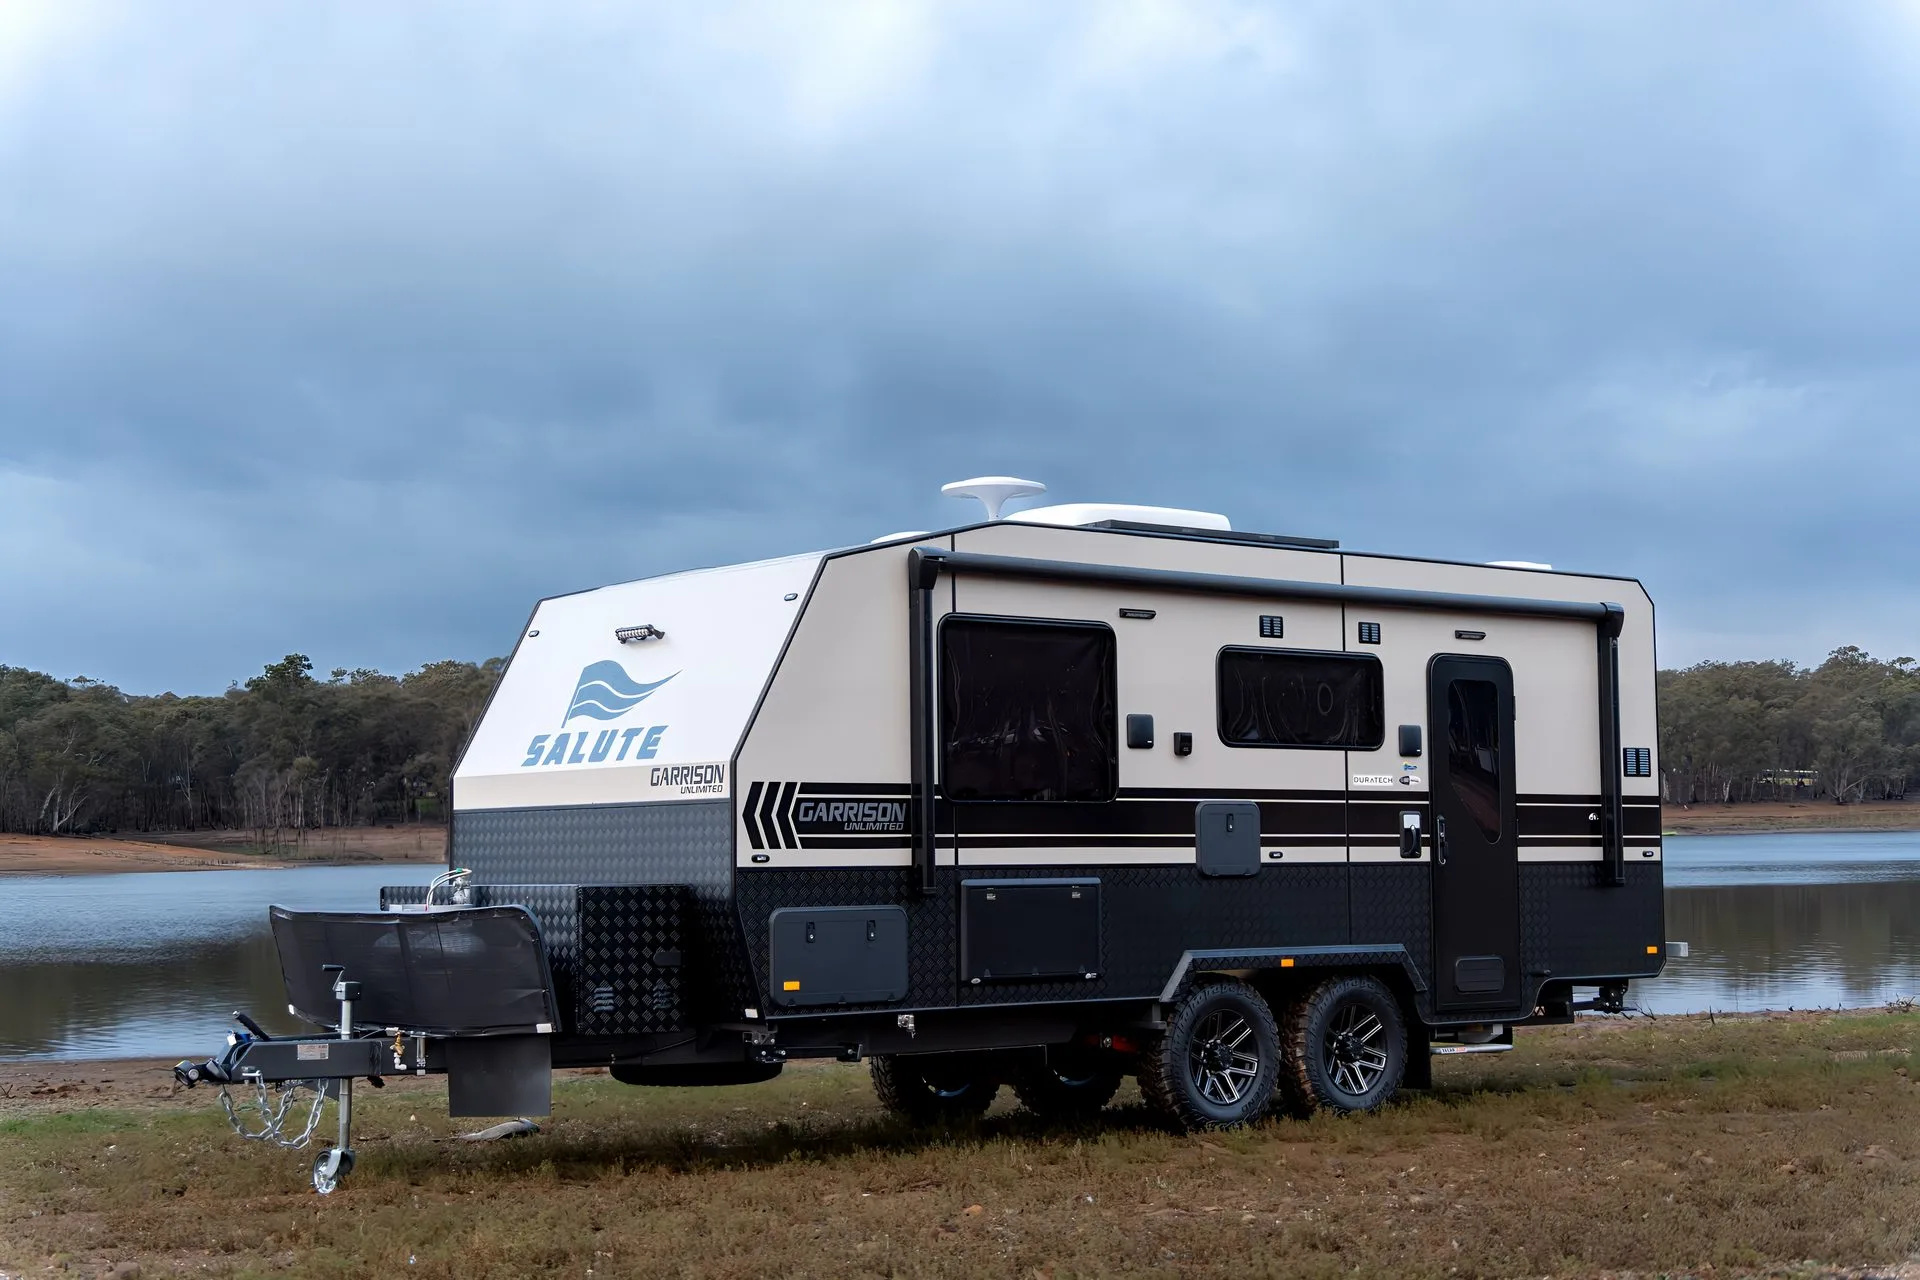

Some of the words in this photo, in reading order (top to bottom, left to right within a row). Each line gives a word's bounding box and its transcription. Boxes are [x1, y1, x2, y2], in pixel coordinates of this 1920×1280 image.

[521, 725, 669, 767] SALUTE
[650, 763, 725, 787] GARRISON
[1353, 776, 1393, 784] DURATECH
[680, 784, 723, 794] UNLIMITED
[798, 802, 907, 822] GARRISON
[844, 822, 904, 831] UNLIMITED
